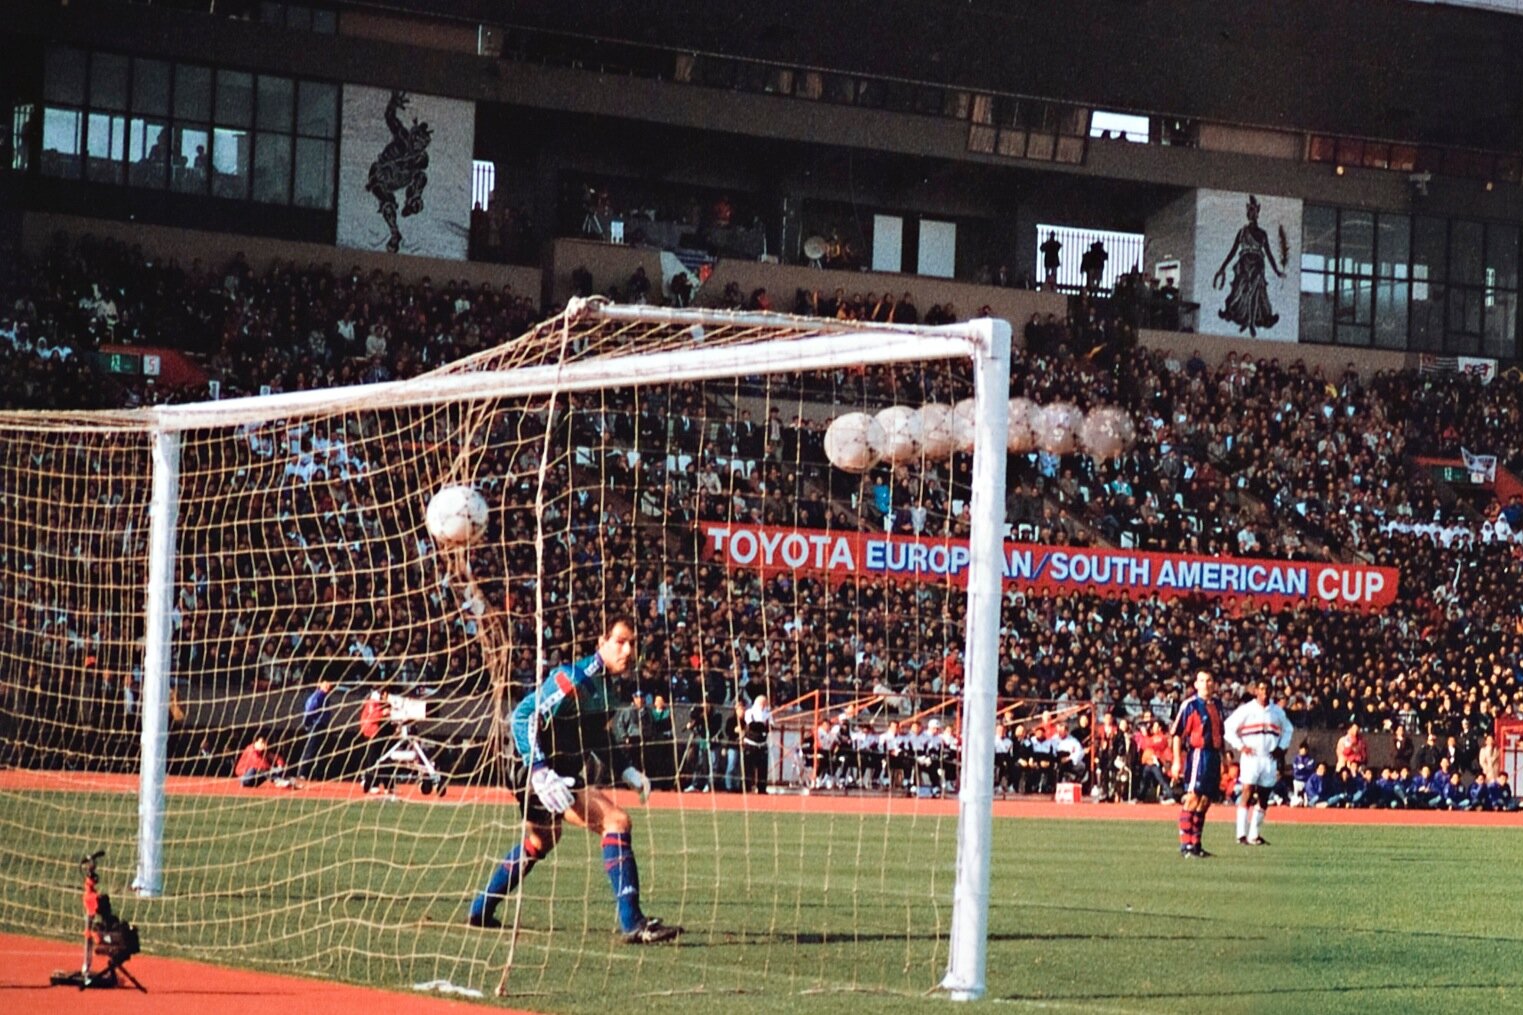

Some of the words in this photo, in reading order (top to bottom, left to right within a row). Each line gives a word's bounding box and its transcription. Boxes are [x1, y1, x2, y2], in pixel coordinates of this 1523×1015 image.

[708, 527, 855, 571] TOYOTA
[866, 540, 1149, 586] EUROPN/SOUTH
[1157, 559, 1308, 595] AMERICAN
[1317, 568, 1385, 601] CUP
